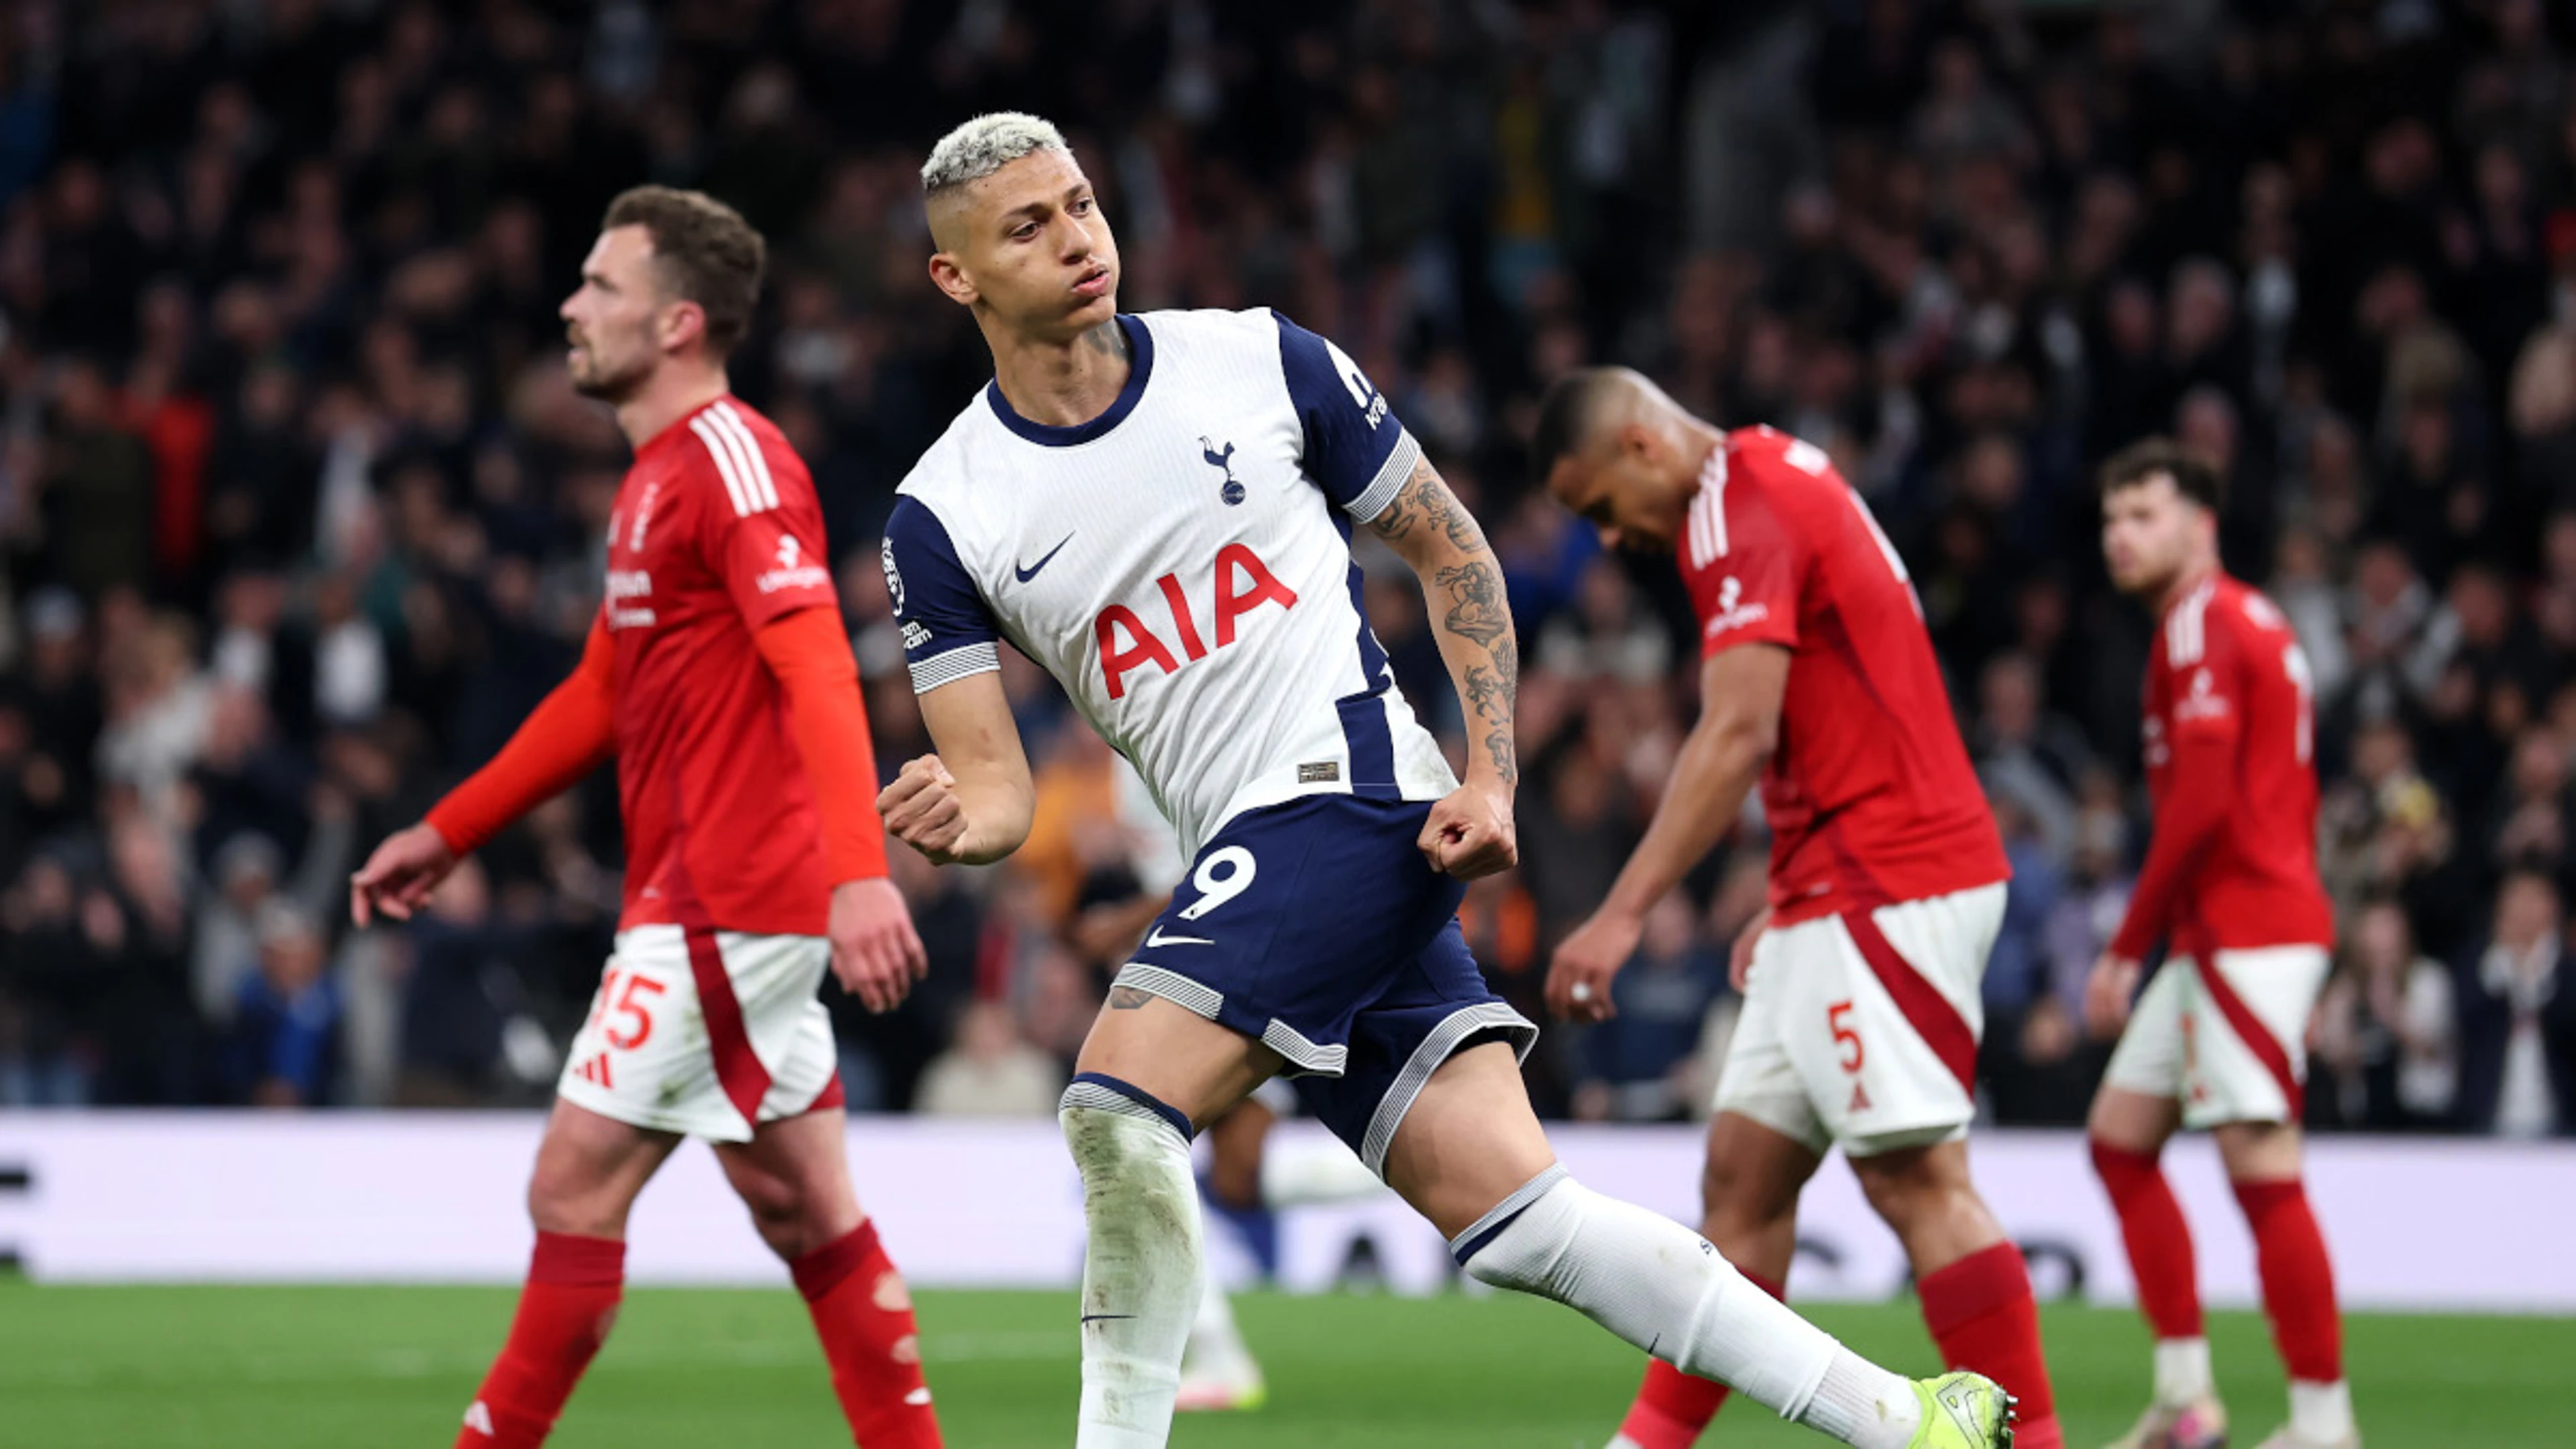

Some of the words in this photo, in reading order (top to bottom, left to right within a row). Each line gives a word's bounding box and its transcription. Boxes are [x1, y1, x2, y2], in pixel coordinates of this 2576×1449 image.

[1094, 543, 1297, 699] AIA
[1178, 845, 1256, 920] 9
[590, 969, 665, 1049] 15
[1827, 999, 1864, 1075] 5
